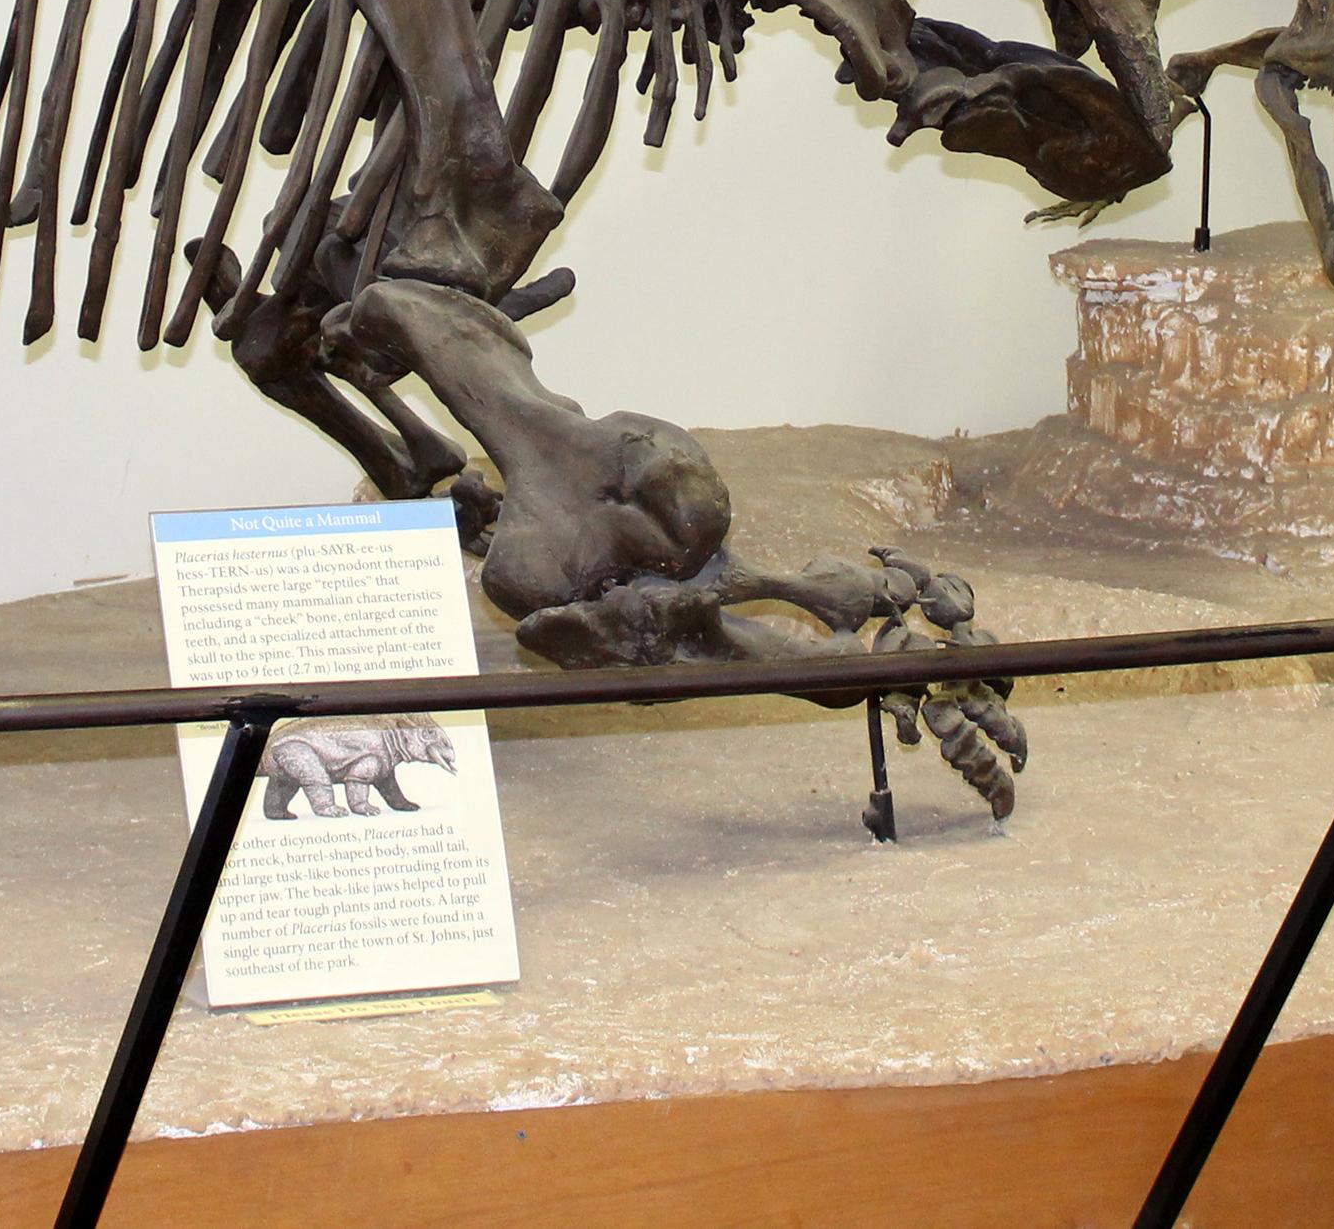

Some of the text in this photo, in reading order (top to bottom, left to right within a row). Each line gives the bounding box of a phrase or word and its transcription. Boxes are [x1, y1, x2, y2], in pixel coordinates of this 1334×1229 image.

[231, 509, 382, 532] Not Quite a Mammal
[174, 542, 393, 563] Placerias hesternus (plu-SAYR-ee-us
[176, 555, 445, 580] hess-TERN-us) was a dicynodont therapsid.
[178, 583, 247, 598] Therapsids
[250, 582, 281, 594] were
[283, 580, 313, 594] large
[375, 574, 401, 586] that
[181, 589, 443, 616] possessed many mammalian characteristics
[183, 617, 243, 630] including
[244, 618, 251, 626] a
[306, 612, 341, 624] bone,
[343, 610, 397, 624] enlarged
[399, 606, 439, 620] canine
[185, 621, 435, 649] teeth, and a specialized attachment of the
[187, 641, 442, 665] skull to the spine. This massive plant-eater
[190, 655, 453, 682] was up to 9 feet (2.7 m) long and might have
[242, 836, 276, 849] other
[279, 831, 361, 848] dicynodonts,
[364, 826, 418, 840] Placerias
[420, 823, 444, 836] had
[446, 825, 453, 834] a
[250, 852, 284, 866] neck,
[286, 846, 373, 863] barrel-shaped
[375, 844, 409, 858] body,
[411, 841, 443, 854] small
[446, 839, 469, 851] tail,
[243, 873, 273, 887] large
[275, 867, 331, 882] tusk-like
[333, 866, 370, 877] bones
[373, 860, 441, 878] protruding
[442, 858, 473, 869] from
[475, 856, 489, 867] its
[218, 872, 486, 908] upper jaw. The beak-like jaws helped to pull
[220, 892, 479, 926] up and tear tough plants and roots. A large
[221, 909, 484, 940] number of Placerias fossils were found in a
[223, 926, 493, 961] single quarry near the town of St. Johns, just
[225, 954, 359, 976] southeast of the park.
